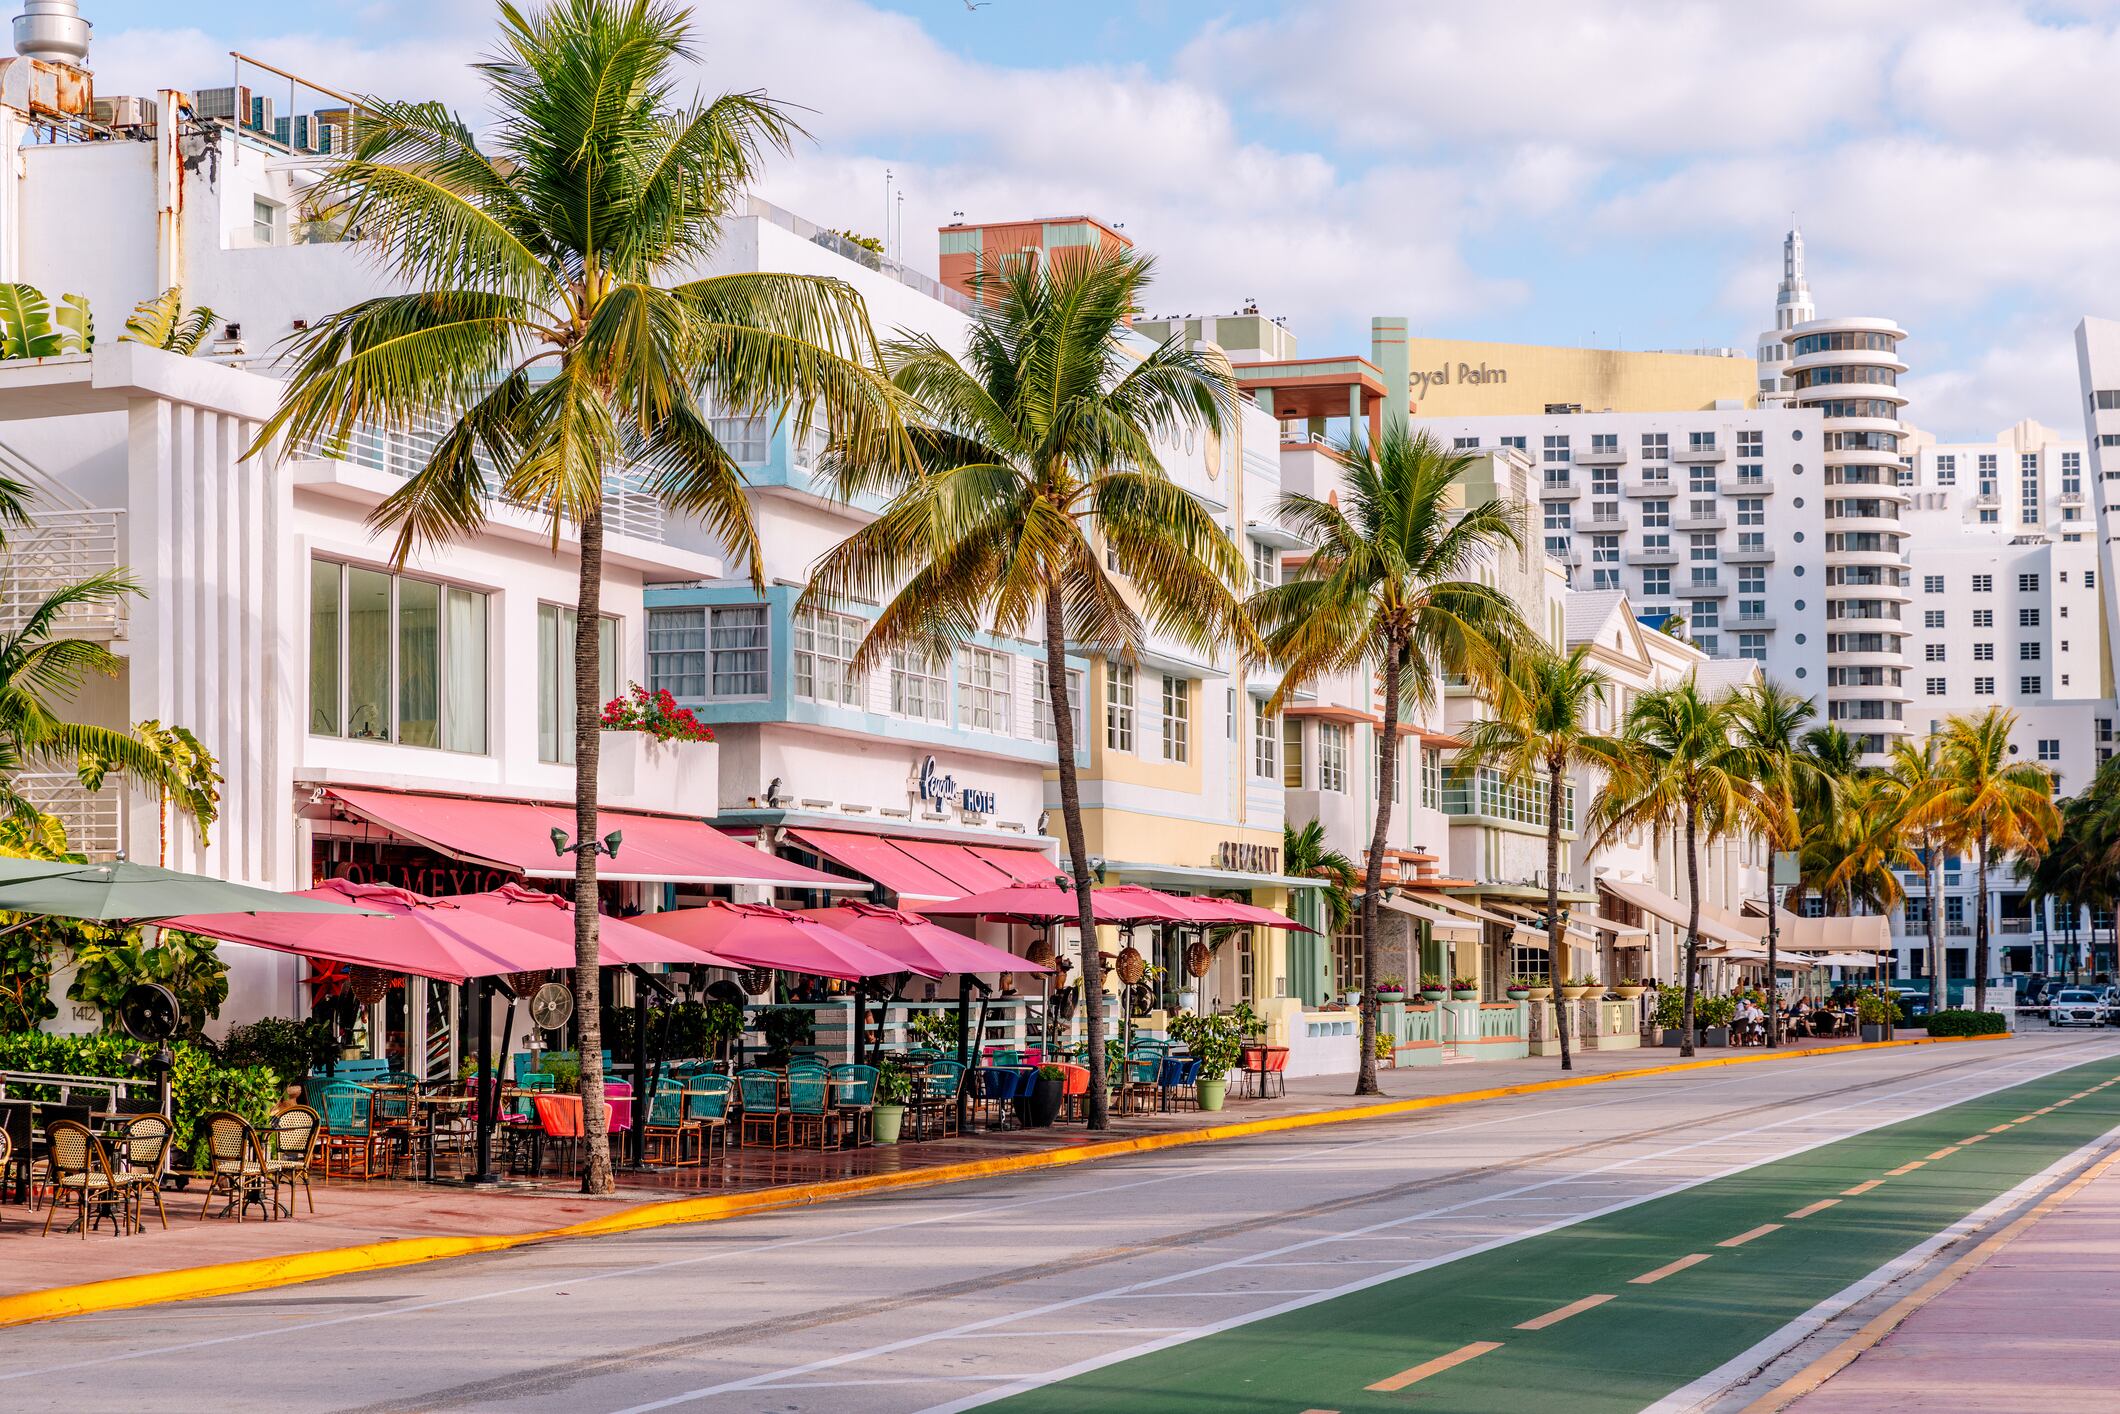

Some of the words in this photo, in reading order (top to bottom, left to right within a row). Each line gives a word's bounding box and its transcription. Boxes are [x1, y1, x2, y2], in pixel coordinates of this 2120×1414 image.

[1408, 361, 1450, 400] oyal
[1458, 361, 1507, 386] Palm
[963, 788, 998, 815] HOTEL
[71, 1005, 97, 1021] 1412
